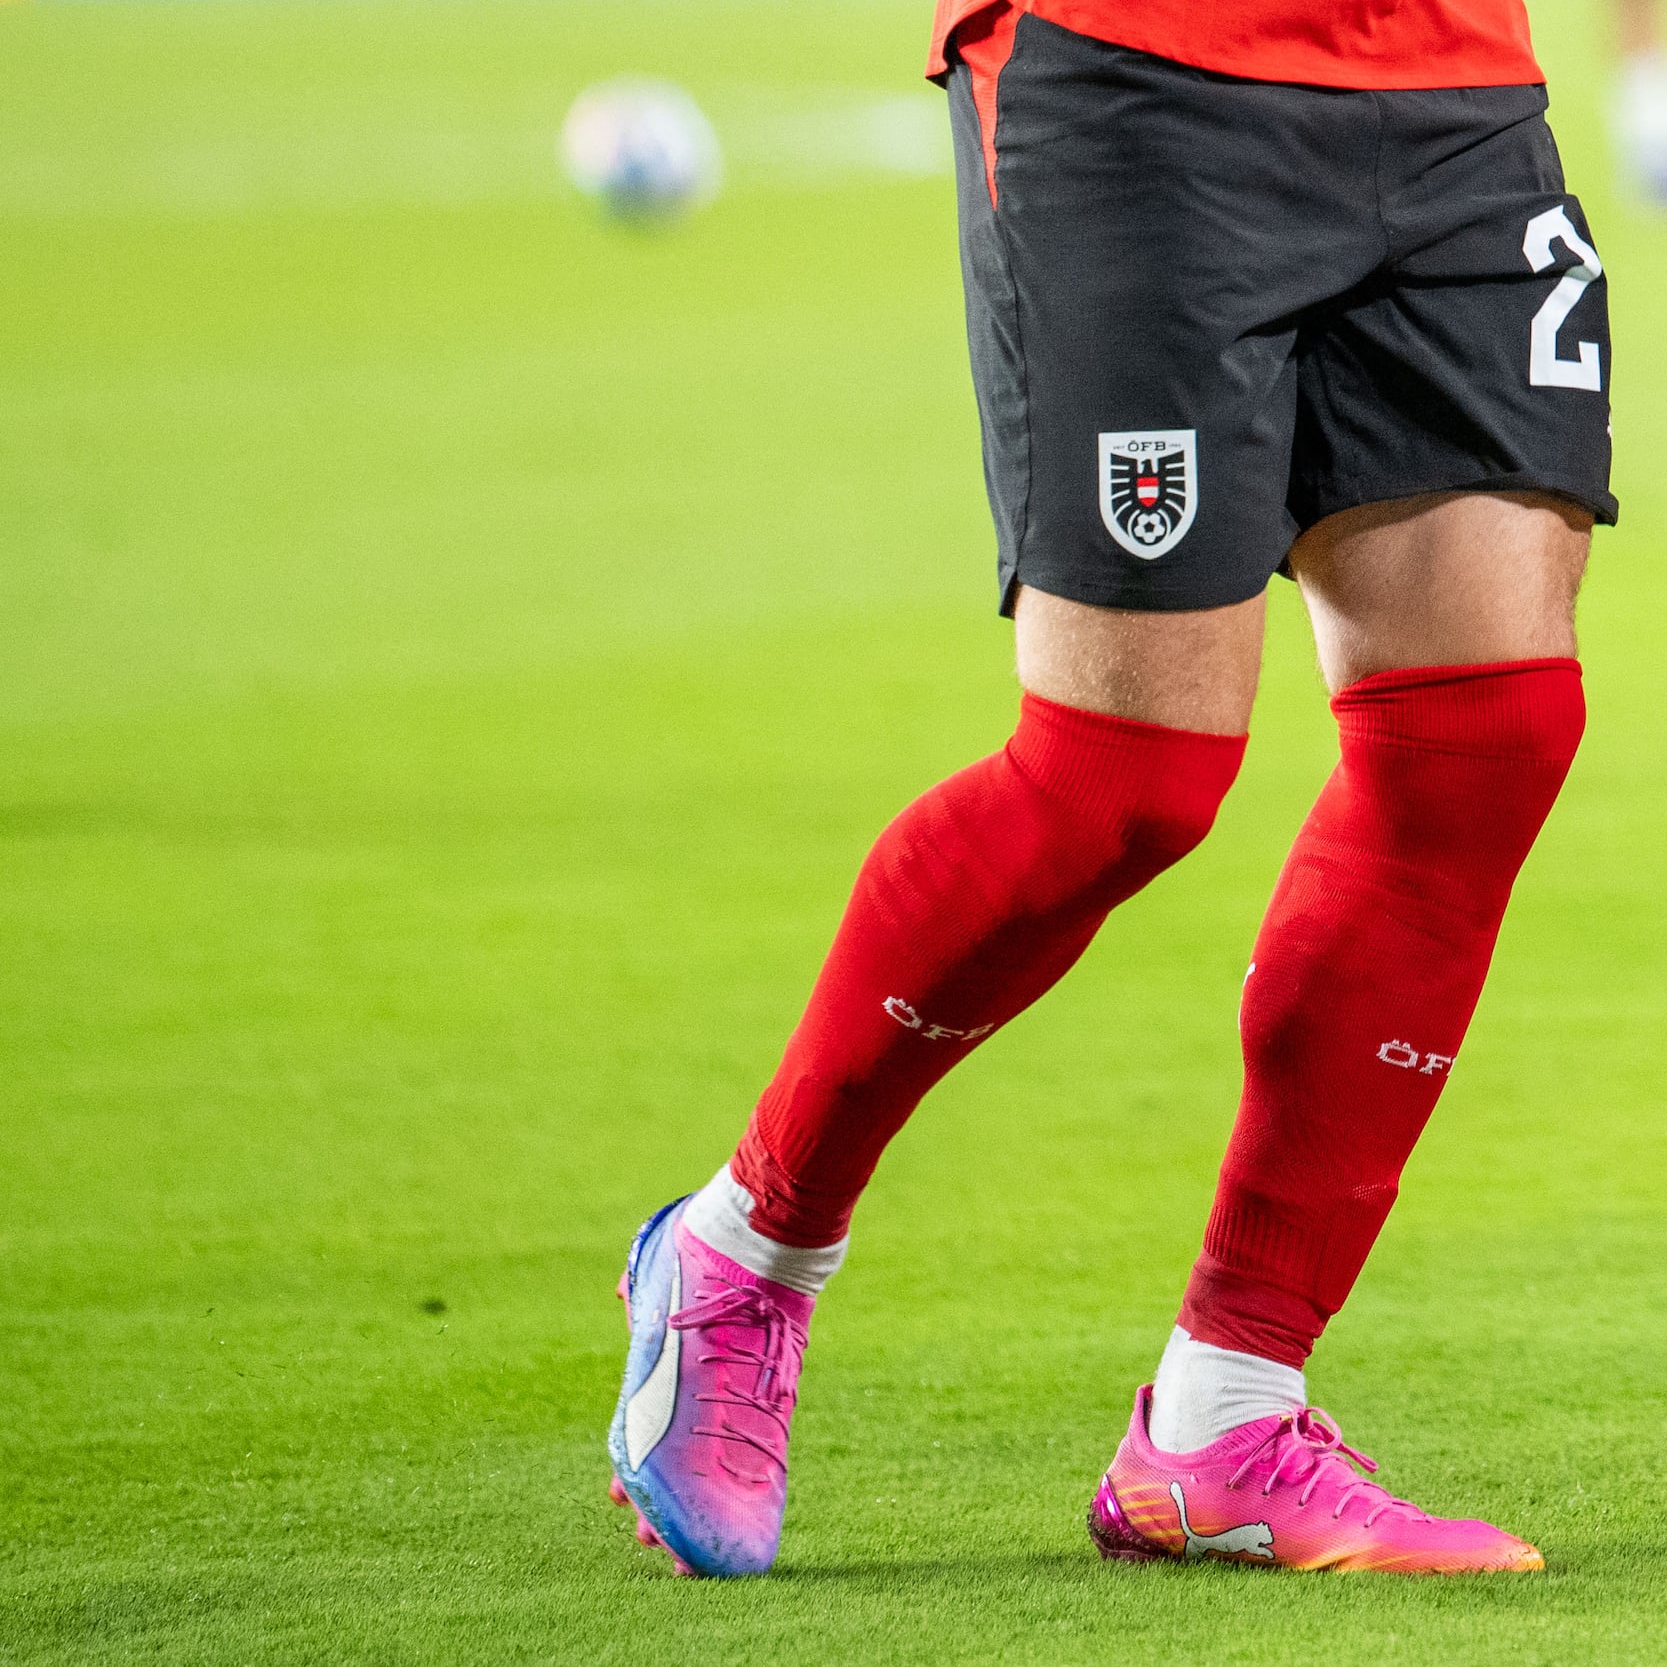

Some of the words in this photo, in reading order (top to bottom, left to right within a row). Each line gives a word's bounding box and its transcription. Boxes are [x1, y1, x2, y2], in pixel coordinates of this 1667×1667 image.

[1521, 205, 1604, 392] 2
[1127, 440, 1166, 452] ÖFB
[1375, 1038, 1457, 1077] ÖF
